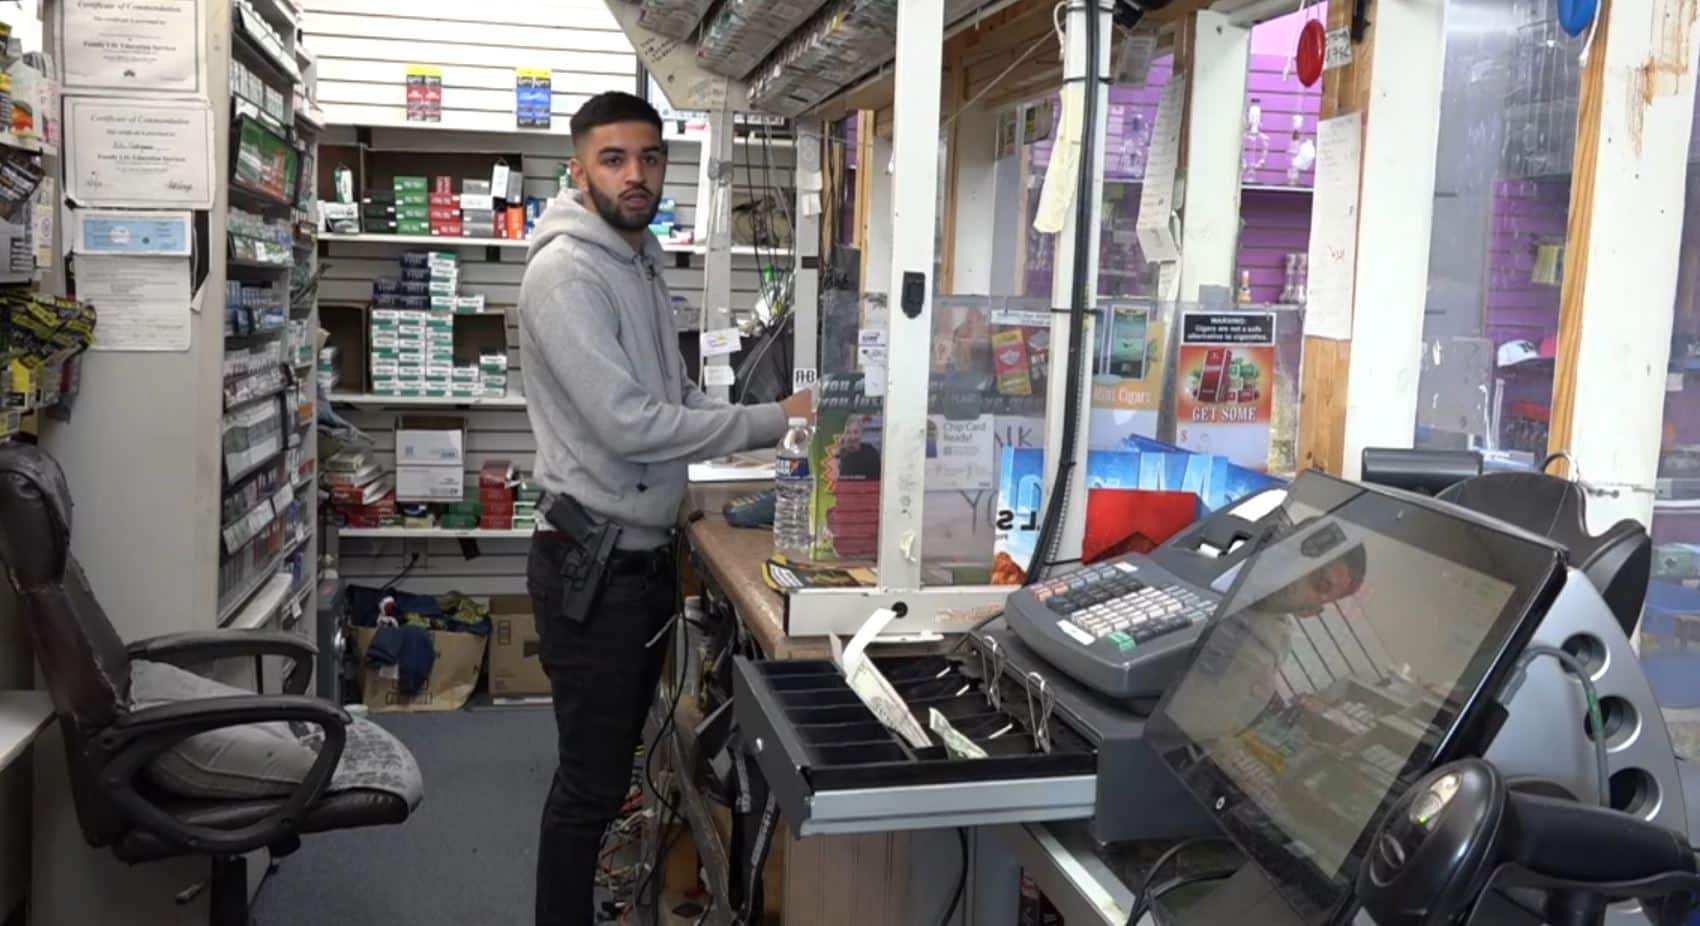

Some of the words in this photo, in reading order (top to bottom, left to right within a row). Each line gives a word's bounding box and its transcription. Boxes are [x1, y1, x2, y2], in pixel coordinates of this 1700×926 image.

[1192, 406, 1215, 421] GET
[1221, 406, 1257, 422] SOME
[943, 422, 964, 432] Chip
[966, 422, 986, 432] Card
